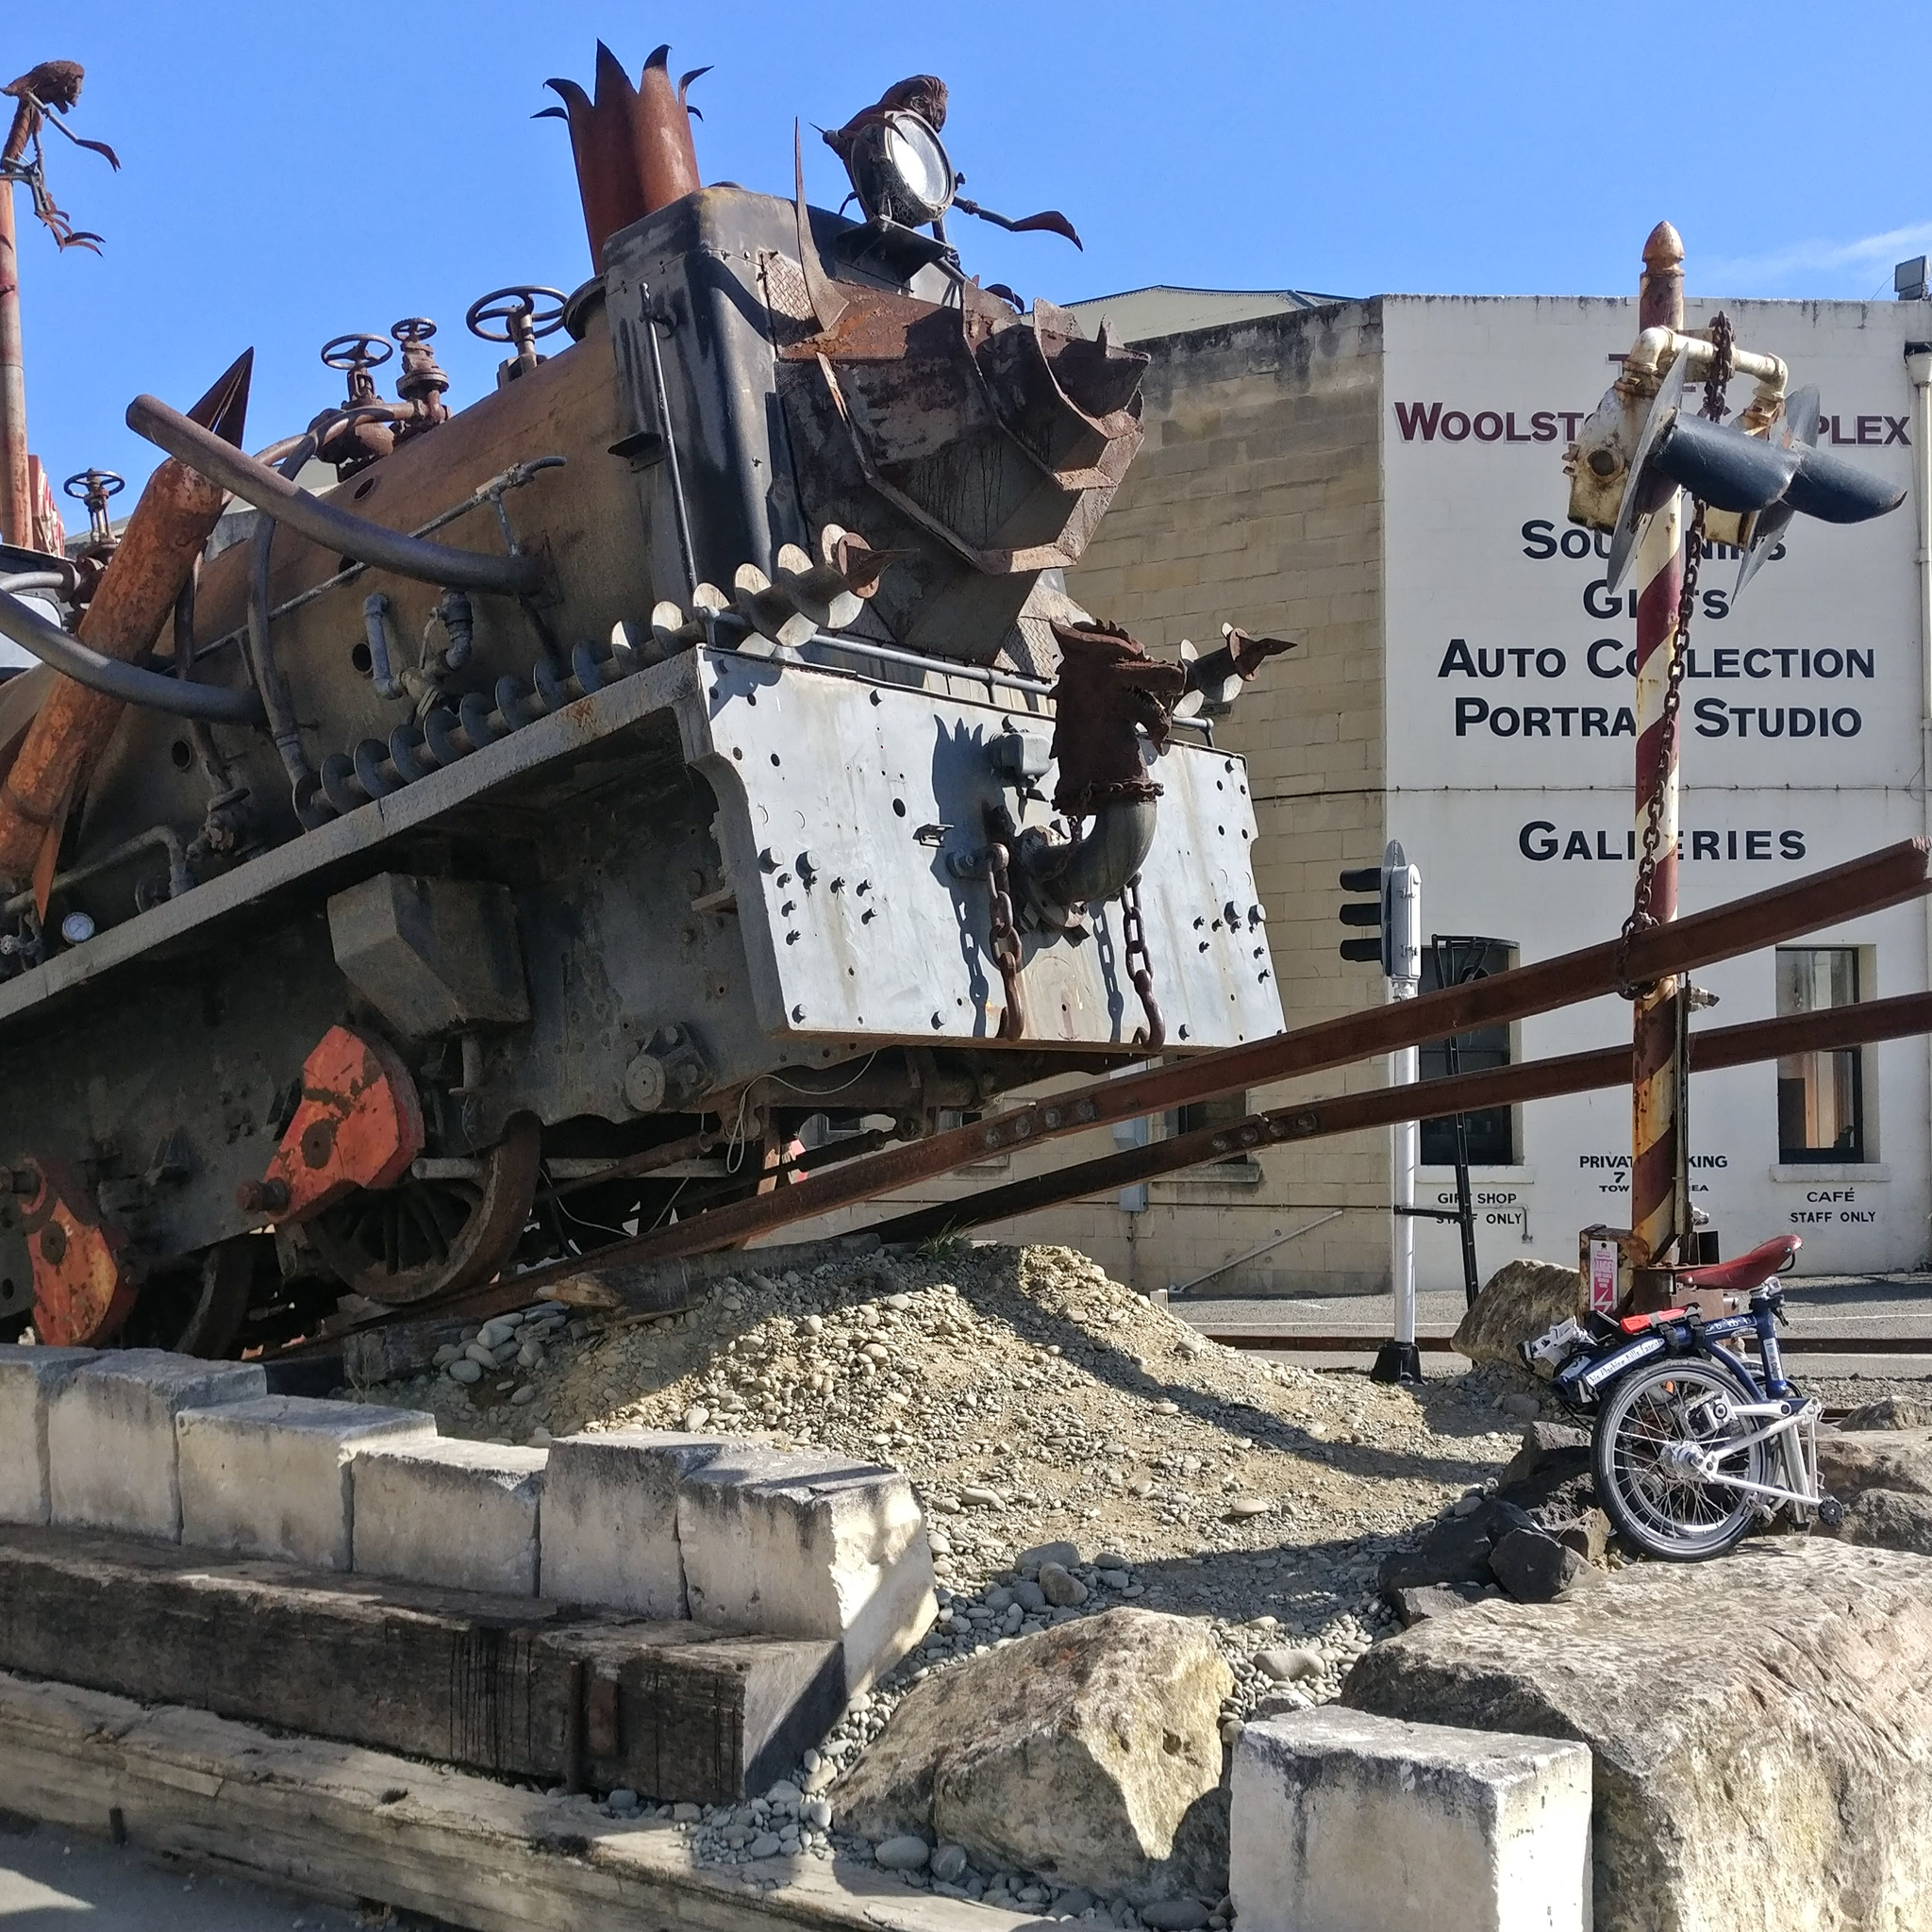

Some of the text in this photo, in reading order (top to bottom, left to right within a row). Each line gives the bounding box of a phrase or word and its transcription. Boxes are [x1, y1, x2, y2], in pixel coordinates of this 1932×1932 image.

[1393, 401, 1596, 441] WOOLST
[1583, 578, 1730, 620] GIS
[1586, 638, 1874, 679] CLECTION
[1455, 696, 1637, 738] PORTRA
[1579, 1155, 1728, 1168] PRIVAT KING
[1614, 1172, 1625, 1183] 7
[1437, 1192, 1517, 1204] GIF SHOP
[1807, 1187, 1855, 1202] CAFÉ
[1486, 1213, 1522, 1224] ONLY
[1790, 1211, 1876, 1223] STAFF ONLY
